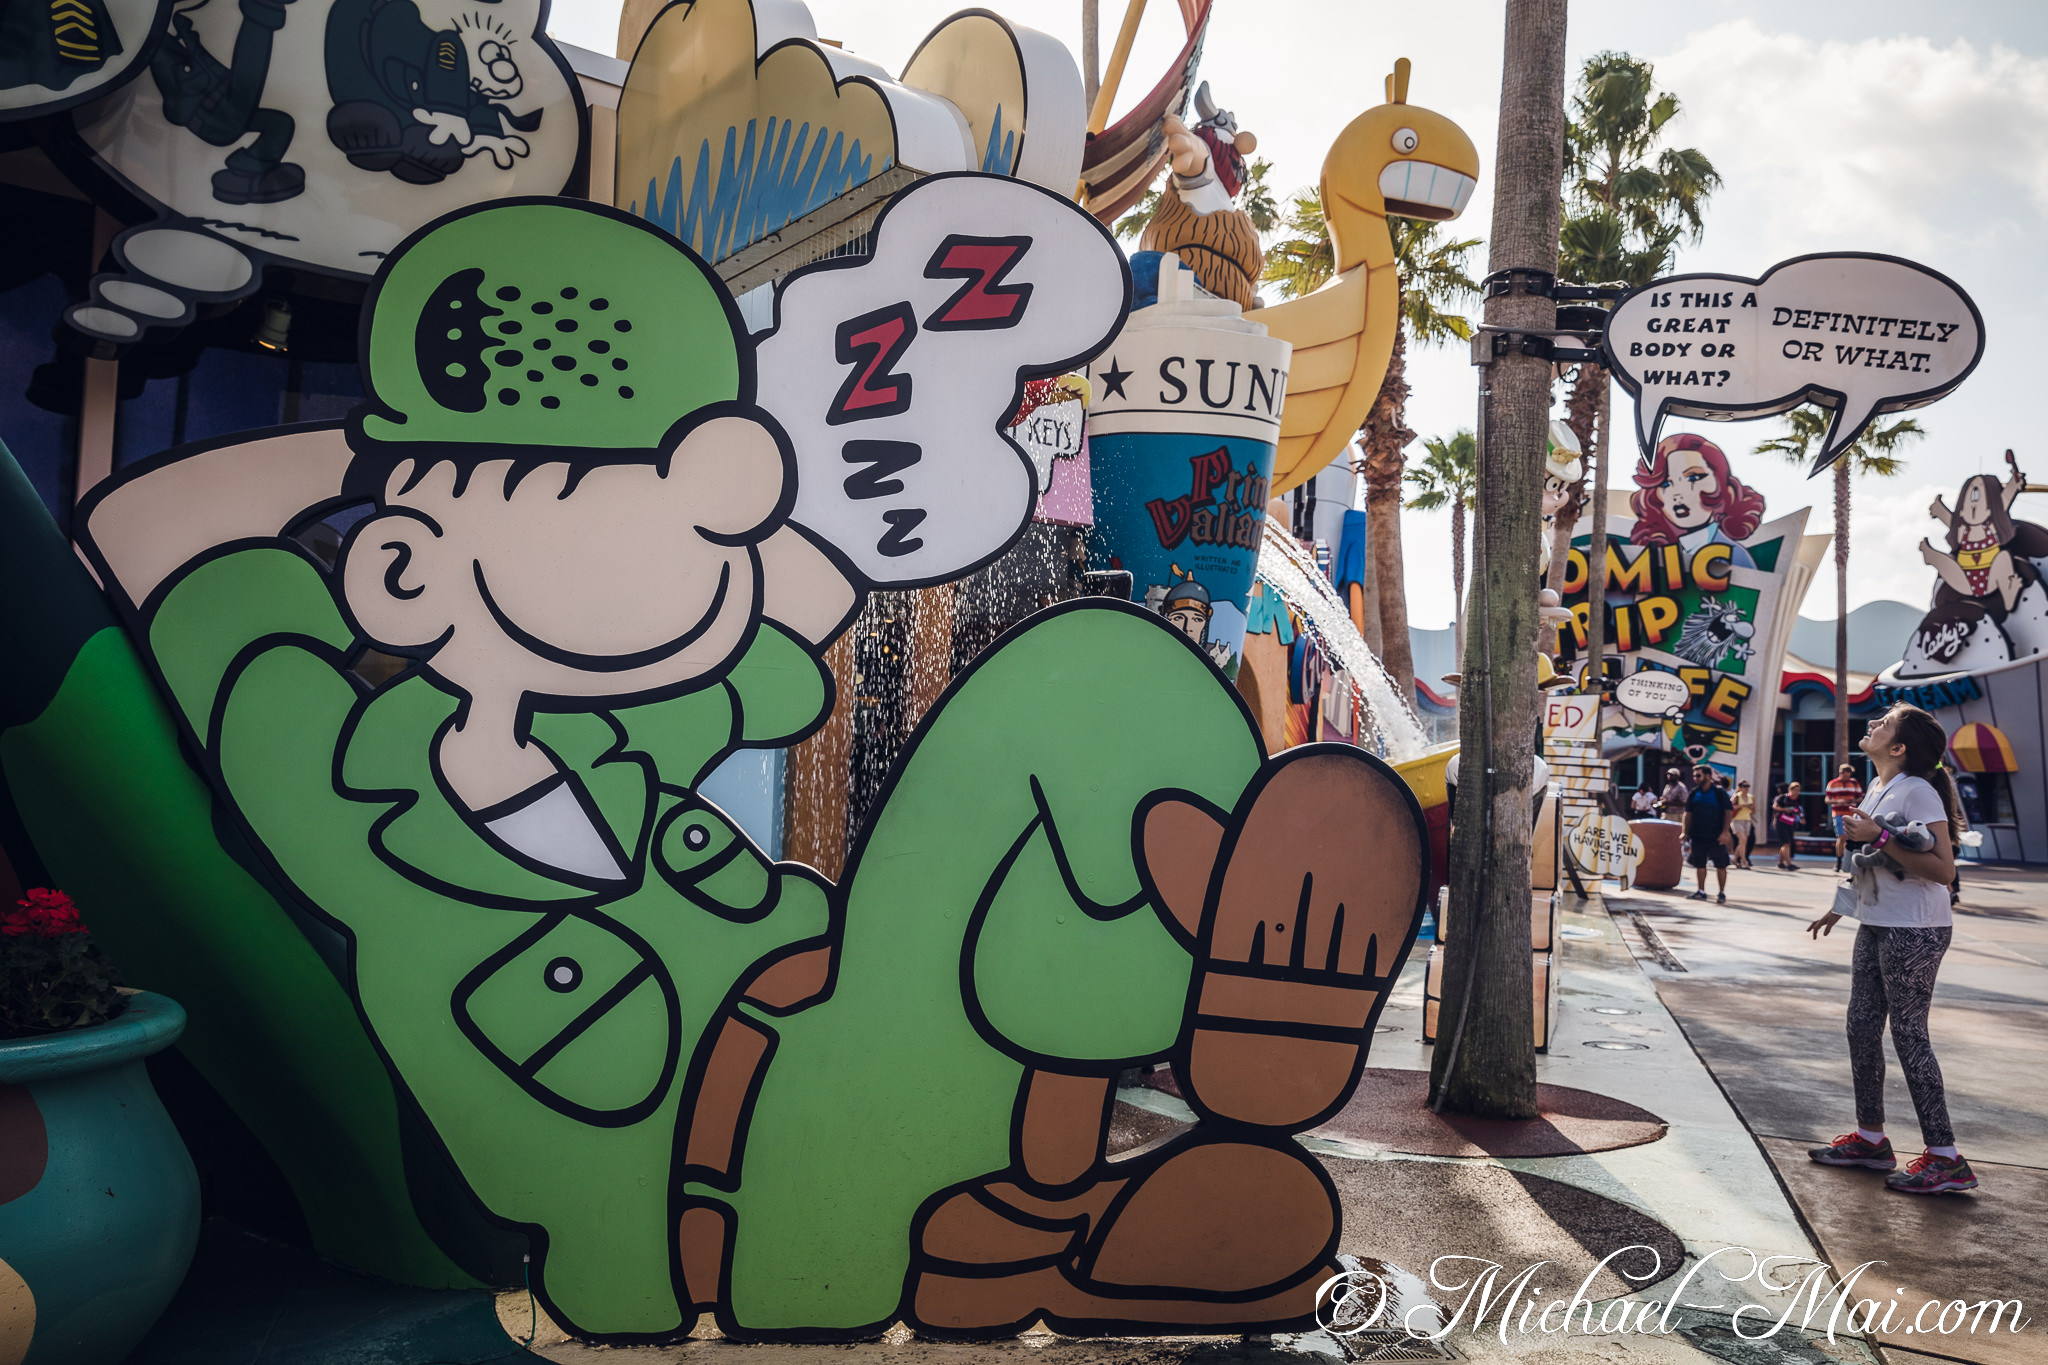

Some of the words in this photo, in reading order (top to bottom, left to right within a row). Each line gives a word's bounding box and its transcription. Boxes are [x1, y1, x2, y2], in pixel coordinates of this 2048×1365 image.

[1651, 292, 1670, 308] IS
[1680, 292, 1733, 308] THIS
[1740, 292, 1758, 308] A
[1646, 318, 1731, 334] GREAT
[1772, 307, 1960, 342] DEFINITELY
[1629, 342, 1693, 357] BODY
[1700, 343, 1736, 358] OR
[1782, 339, 1824, 362] OR
[1835, 344, 1931, 373] WHAT.
[1160, 357, 1288, 419] SUN
[1643, 369, 1731, 387] WHAT?
[1190, 445, 1268, 513] Prin
[1145, 494, 1264, 552] Valian
[1194, 555, 1227, 564] WRITTEN
[1563, 543, 1733, 594] OMIC
[1921, 622, 1970, 660] Cathy's
[1627, 689, 1641, 697] OF
[1630, 678, 1683, 692] THINKING
[1548, 703, 1584, 729] ED
[1574, 833, 1611, 851] HAVING
[1616, 843, 1638, 857] FUN
[1585, 826, 1606, 839] ARE
[1610, 831, 1629, 845] WE
[1591, 848, 1622, 864] YET?
